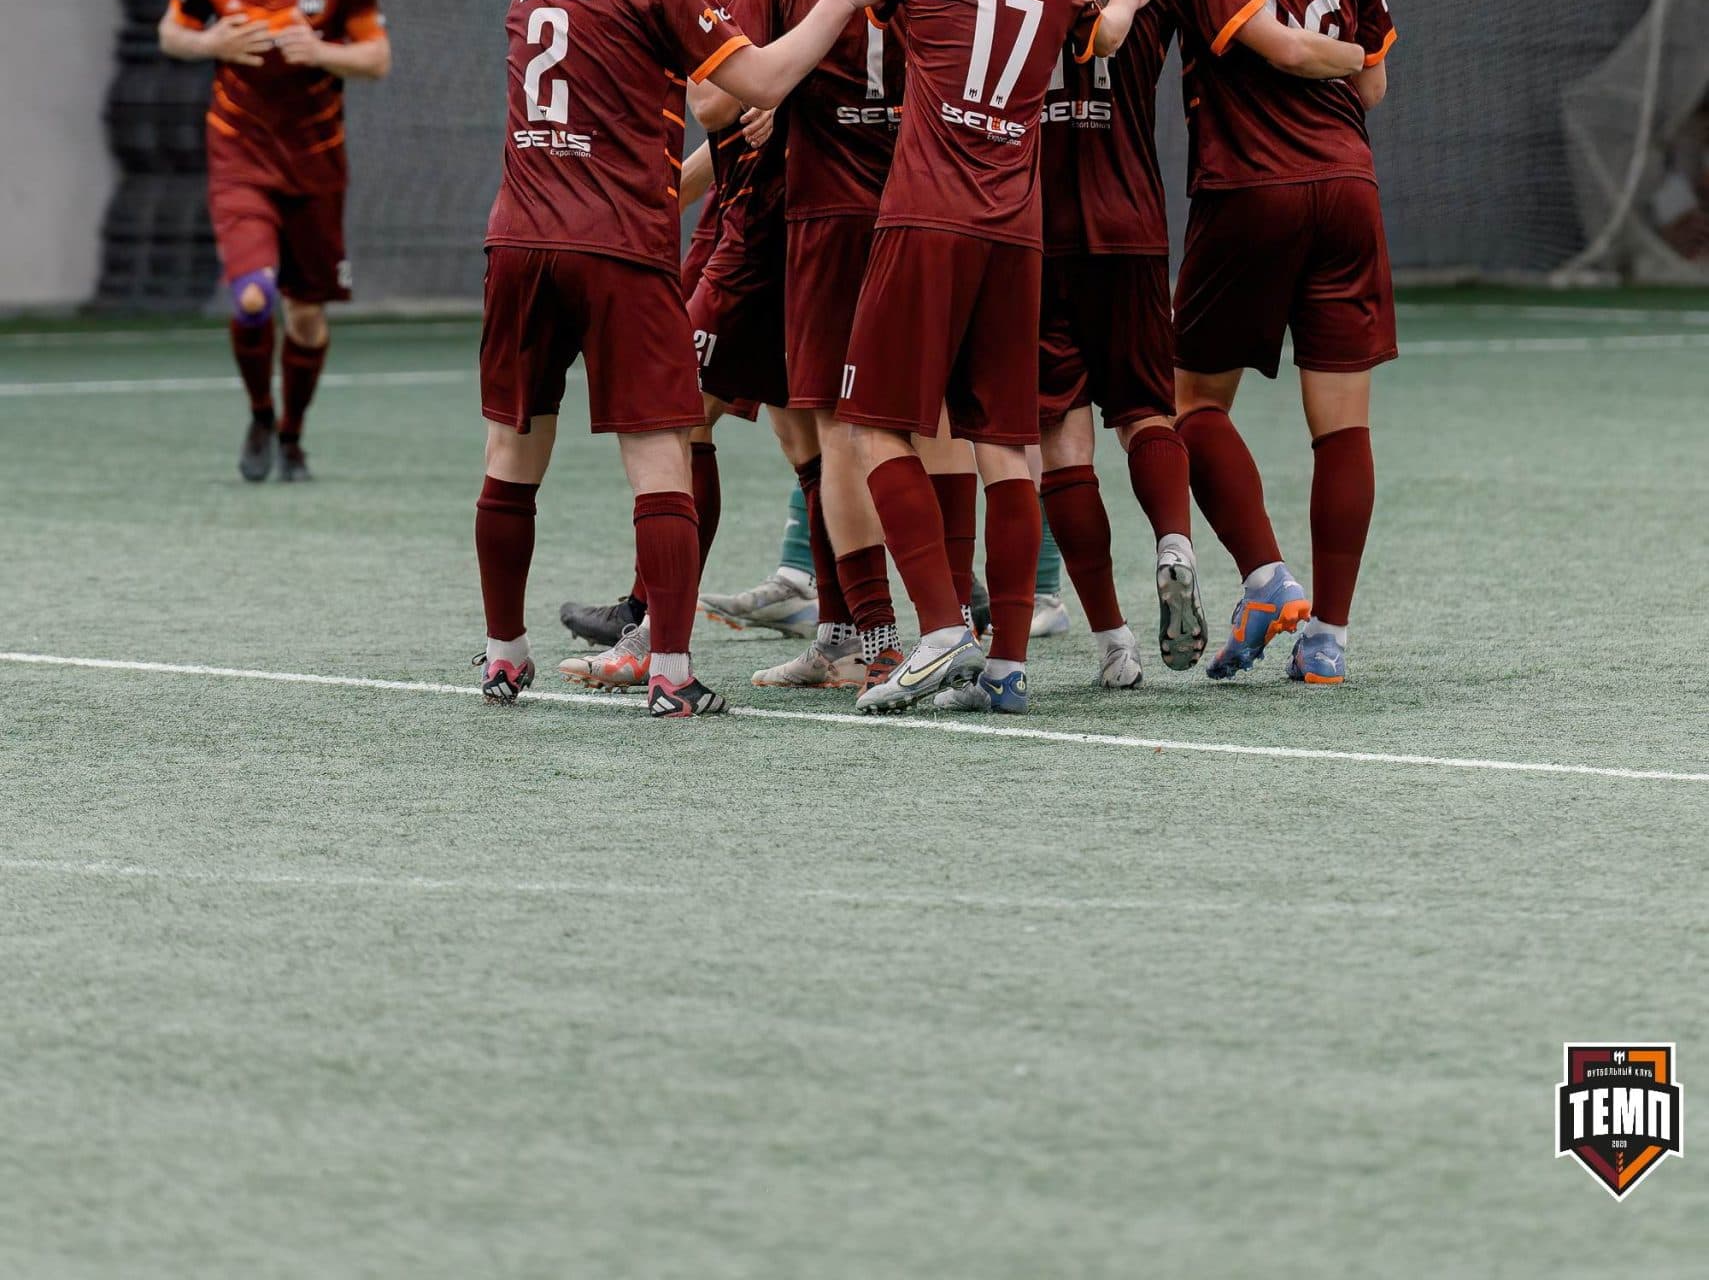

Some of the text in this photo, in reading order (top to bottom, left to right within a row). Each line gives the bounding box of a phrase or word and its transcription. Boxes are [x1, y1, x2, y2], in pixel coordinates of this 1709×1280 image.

[524, 6, 569, 124] 2
[941, 102, 1026, 138] SEUS
[513, 129, 591, 152] SEUS
[840, 364, 857, 400] 17
